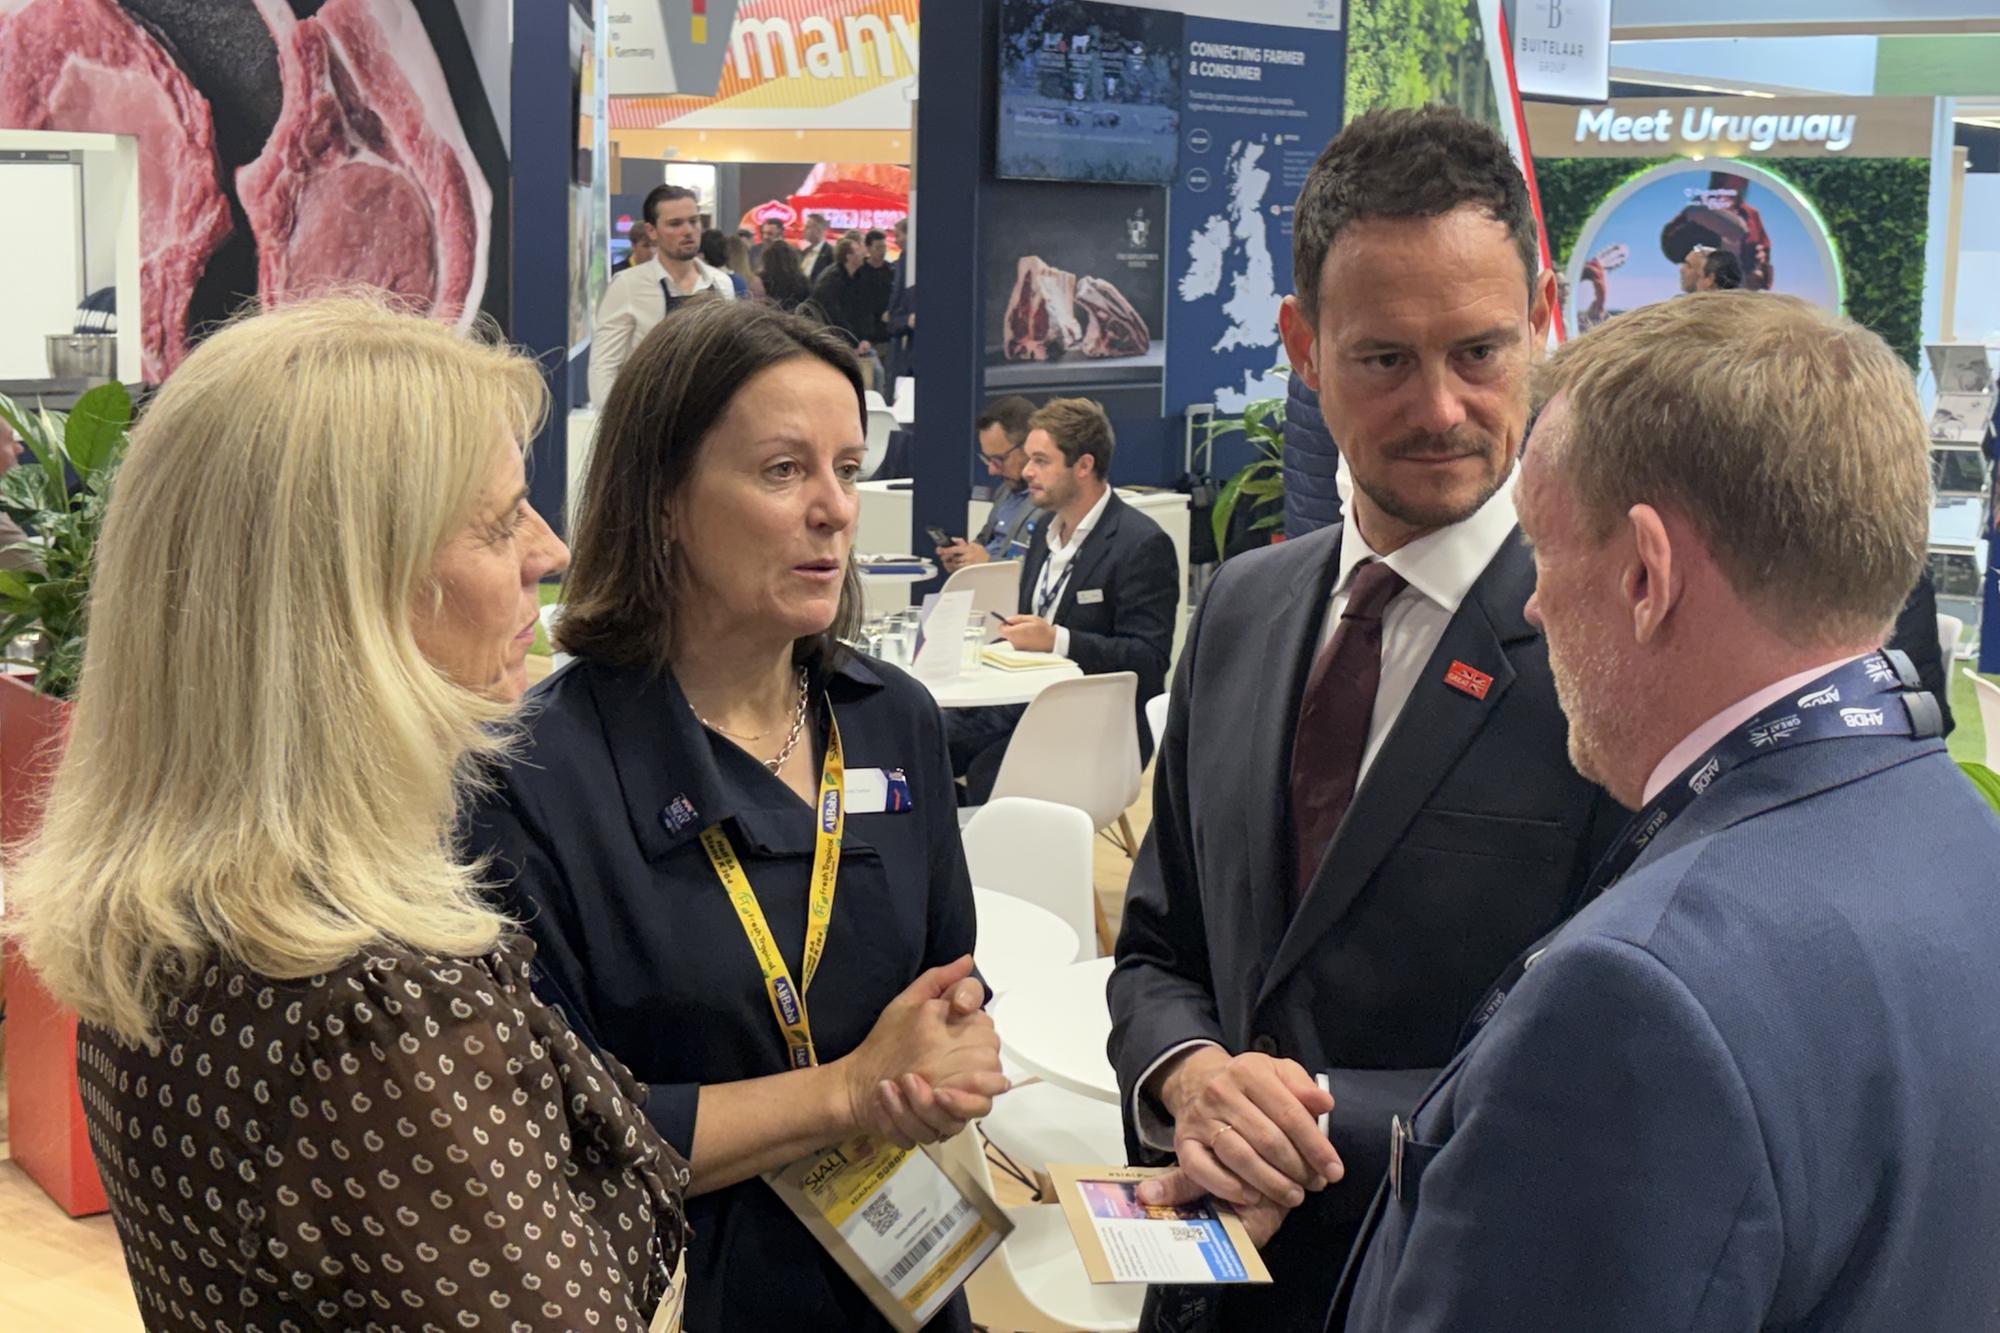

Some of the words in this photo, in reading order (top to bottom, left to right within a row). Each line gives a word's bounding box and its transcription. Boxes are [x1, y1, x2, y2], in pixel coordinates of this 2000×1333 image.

[1190, 41, 1262, 62] CONNECTING
[1263, 49, 1305, 66] FARMER
[1521, 37, 1584, 58] BUITELAAR
[1189, 61, 1198, 76] &
[1200, 62, 1262, 81] CONSUMER
[1574, 107, 1673, 142] Meet
[1680, 107, 1857, 151] Uruguay
[1769, 716, 1801, 732] GREAT
[1843, 711, 1884, 728] AHDB
[1694, 759, 1720, 794] AHDB
[804, 1157, 840, 1191] SIAL
